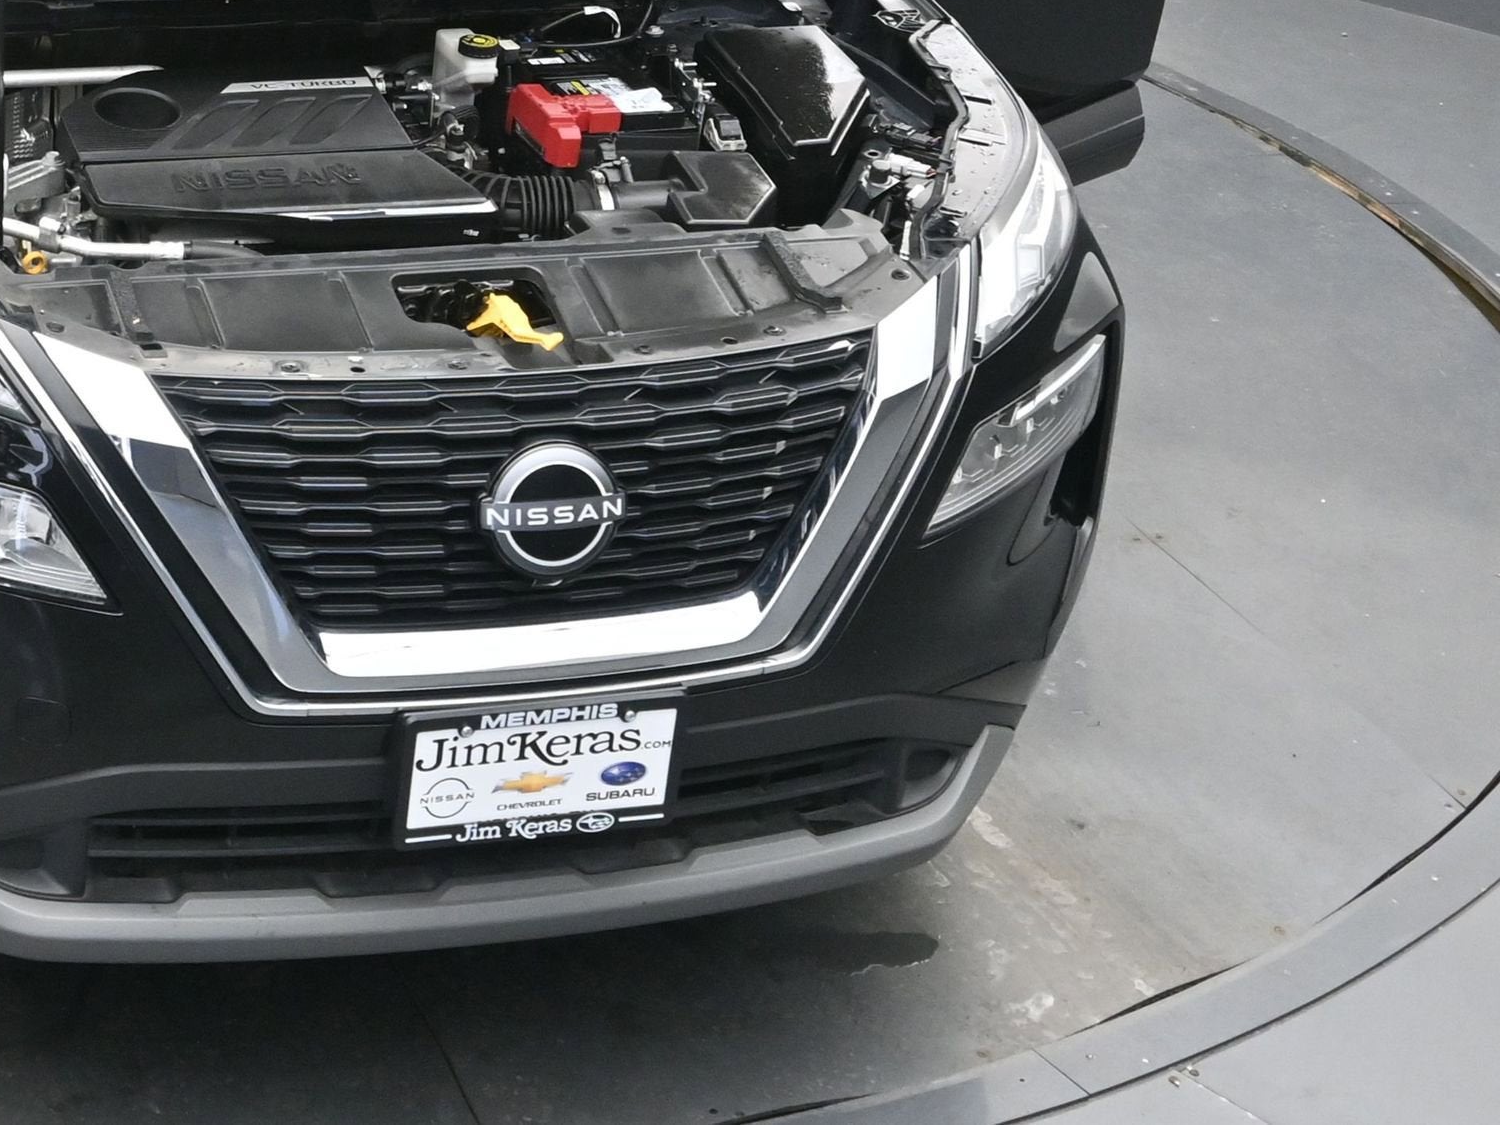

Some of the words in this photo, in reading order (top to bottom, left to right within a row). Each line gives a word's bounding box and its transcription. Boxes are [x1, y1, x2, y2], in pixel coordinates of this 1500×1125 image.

[171, 163, 362, 193] NISSAN
[486, 498, 622, 526] NISSAN
[480, 703, 619, 730] MEMPHIS
[419, 792, 476, 805] NISSAN
[496, 798, 563, 811] CHEVROLET
[585, 787, 656, 802] SUBARU
[455, 823, 502, 842] Jim
[505, 817, 574, 839] Keras
